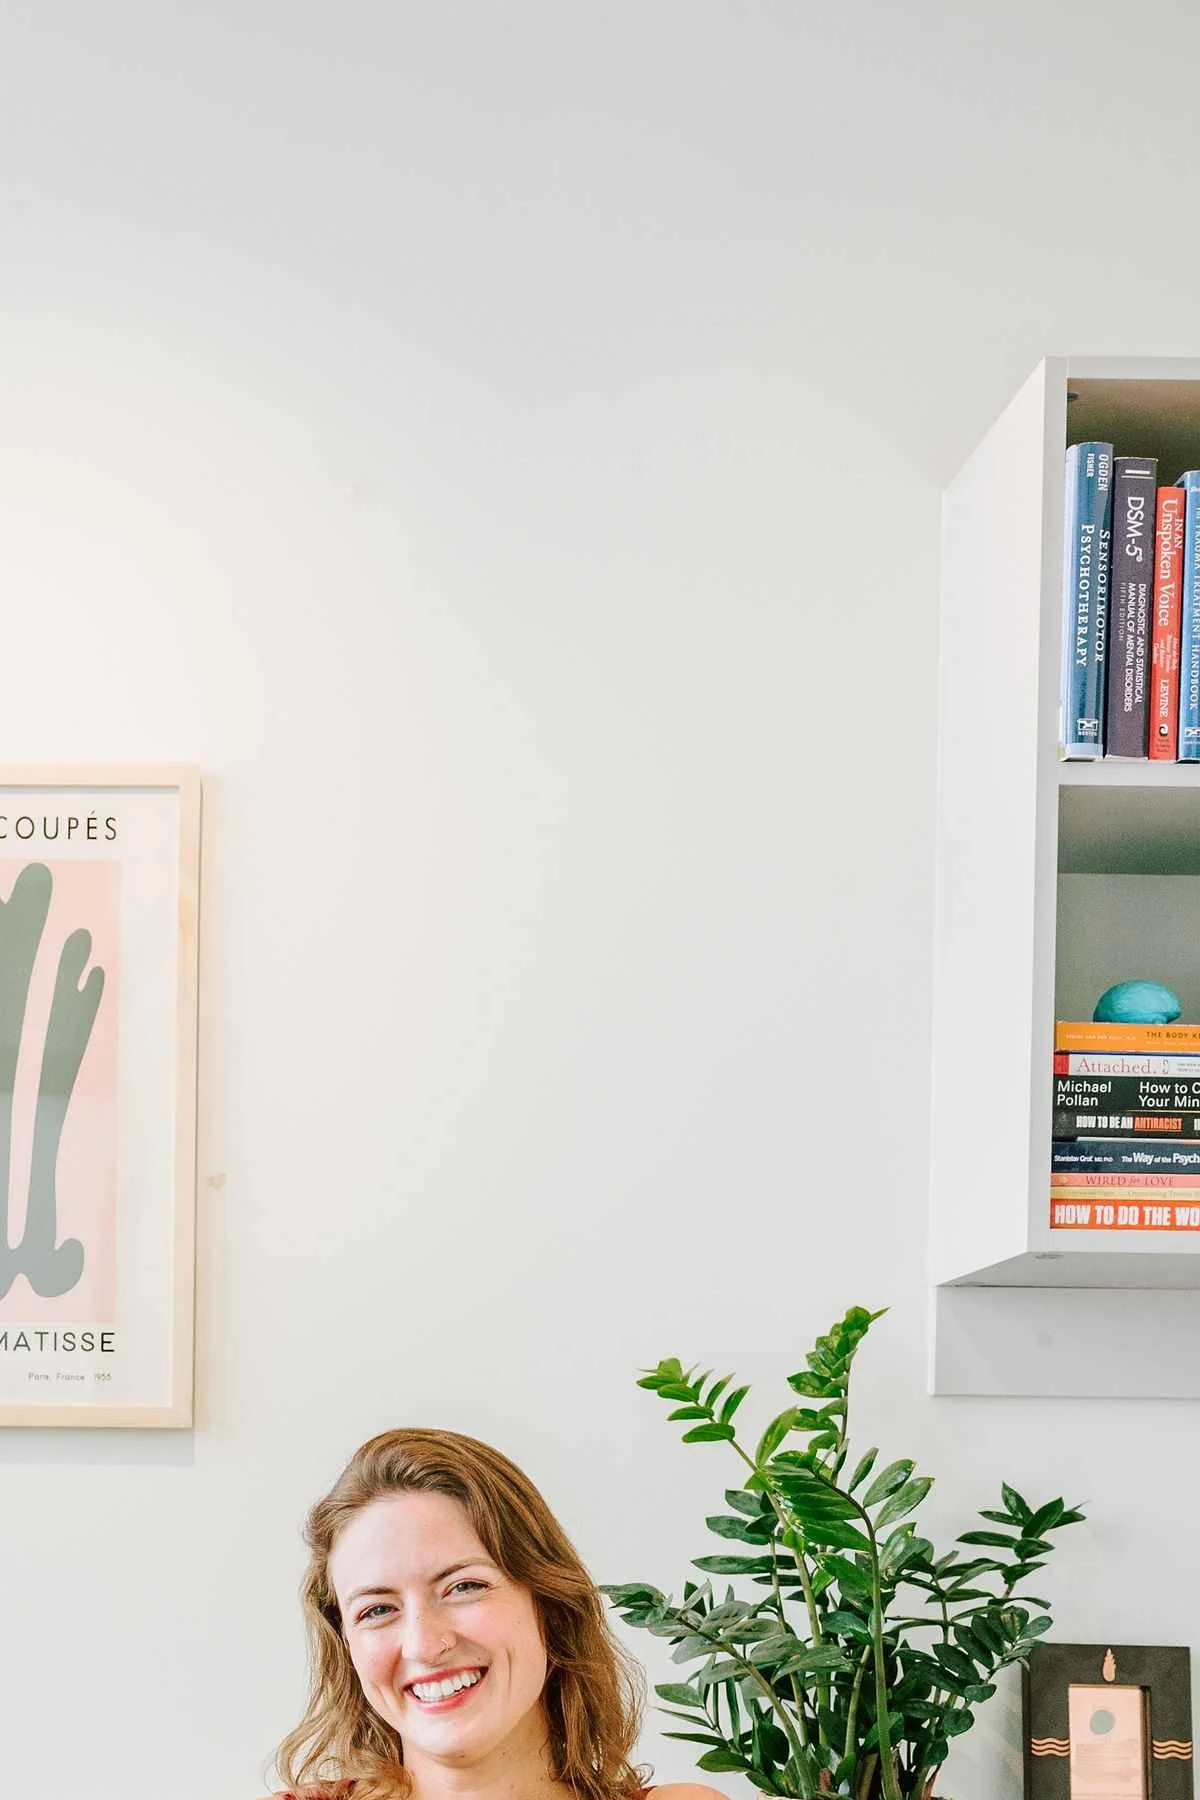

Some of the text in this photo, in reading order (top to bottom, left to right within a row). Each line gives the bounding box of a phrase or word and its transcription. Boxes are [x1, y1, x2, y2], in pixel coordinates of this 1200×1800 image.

[1098, 454, 1109, 491] OGDEN
[1156, 499, 1178, 579] Unspoken
[1076, 524, 1095, 667] PSYCHOTHERAPY
[1095, 529, 1111, 663] SENSORIMOTOR
[1158, 582, 1175, 626] Voice
[1118, 607, 1127, 641] EDITION
[1123, 582, 1137, 712] MANUAL OF MENTAL DISORDERS
[1134, 583, 1147, 703] DIAGNOSTIC AND STATISTICAL
[1189, 644, 1200, 711] HANDBOOK
[1159, 679, 1169, 717] LEVINE
[1166, 1031, 1189, 1040] BODY
[1057, 1080, 1112, 1093] Michael
[1057, 1094, 1099, 1106] Pollan
[1138, 1095, 1170, 1108] Your
[1140, 1081, 1171, 1094] How
[1174, 1083, 1188, 1094] to
[1076, 1115, 1096, 1128] HOW
[1097, 1116, 1109, 1128] TO
[1109, 1116, 1120, 1128] BE
[1121, 1116, 1133, 1129] AN
[1134, 1117, 1183, 1131] ANTIRACIST
[1133, 1152, 1154, 1165] Way
[1086, 1175, 1126, 1186] WIRED
[1144, 1176, 1175, 1186] LOVE
[1054, 1204, 1091, 1225] HOW
[1094, 1205, 1114, 1226] TO
[1118, 1205, 1139, 1226] DO
[1143, 1206, 1171, 1226] THE
